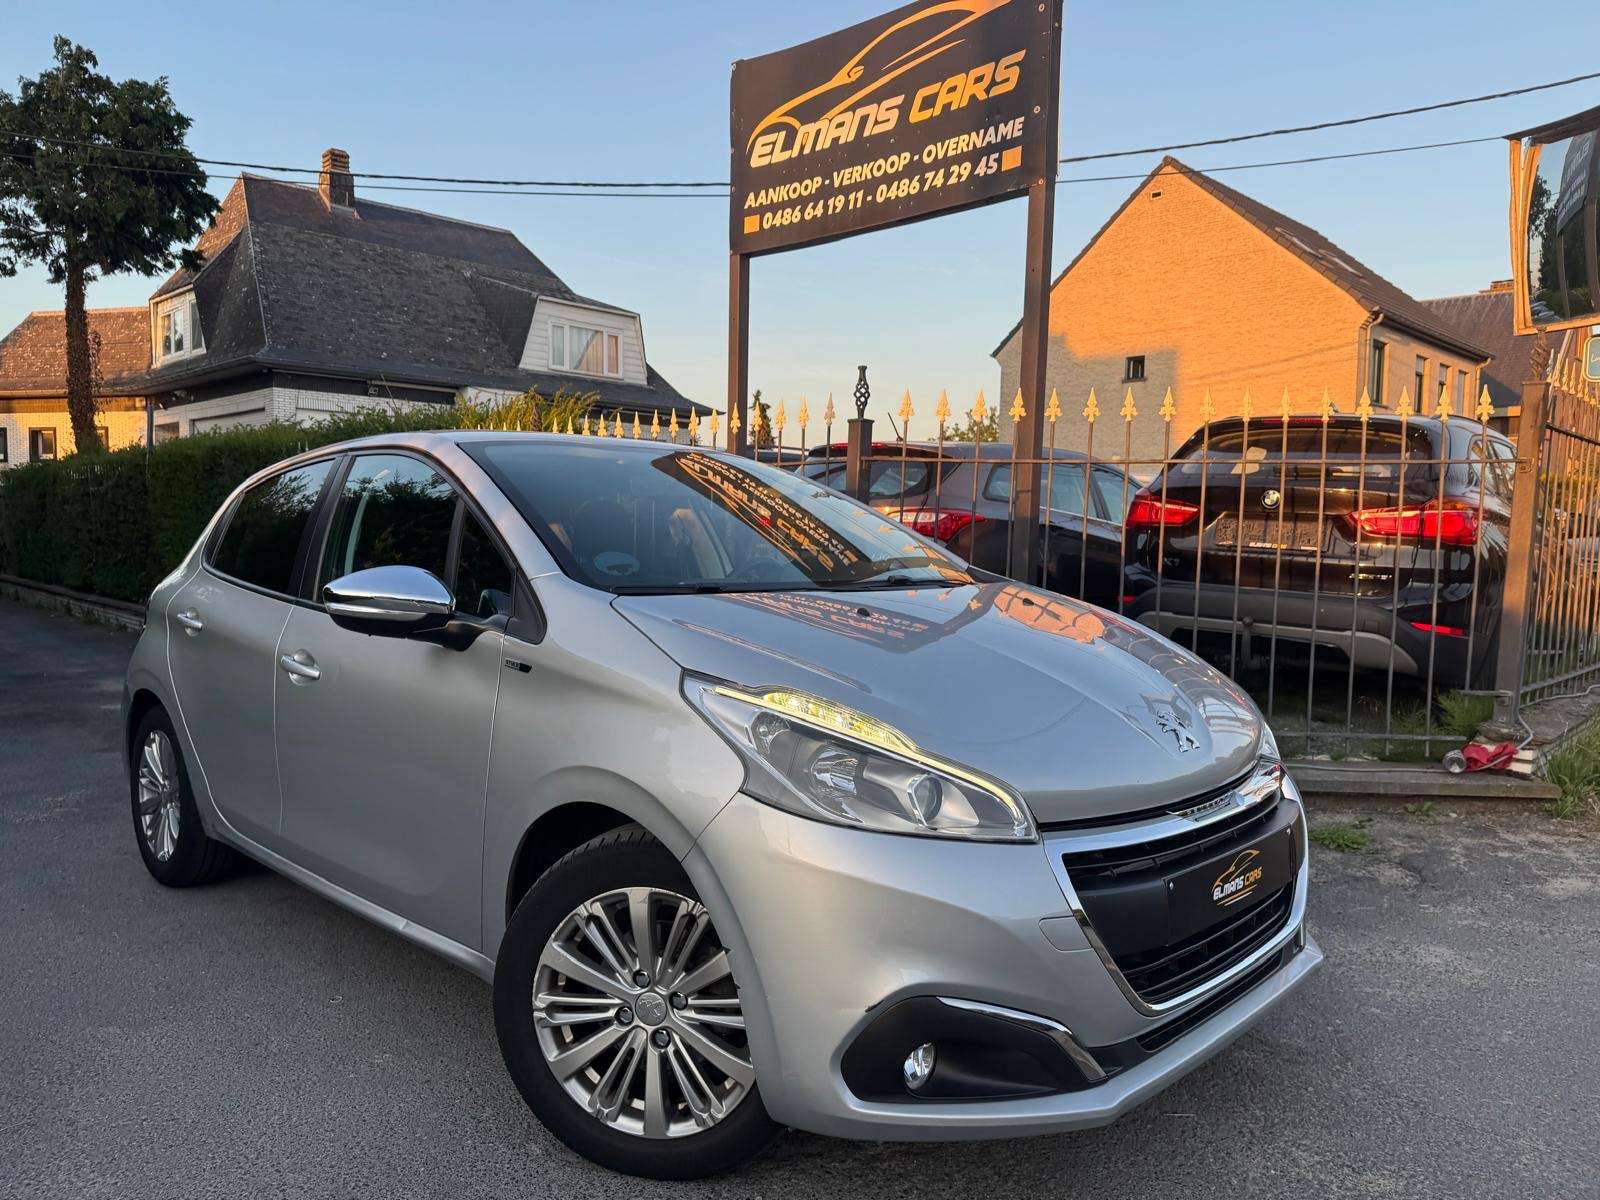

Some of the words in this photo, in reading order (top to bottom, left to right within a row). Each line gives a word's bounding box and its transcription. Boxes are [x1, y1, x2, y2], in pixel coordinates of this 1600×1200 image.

[750, 94, 905, 168] ELMANS
[909, 49, 1027, 124] CARS
[744, 176, 822, 209] AANKOOP
[833, 152, 911, 188] VERKOOP
[922, 116, 1025, 164] OVERNAME
[762, 205, 801, 229] 0486
[804, 200, 824, 220] 64
[828, 195, 845, 215] 19
[848, 190, 864, 210] 11
[875, 174, 920, 203] 0486
[923, 168, 944, 192] 74
[947, 161, 972, 185] 29
[974, 152, 999, 177] 45
[1213, 875, 1244, 900] ELMANS
[1244, 866, 1263, 886] CARS
